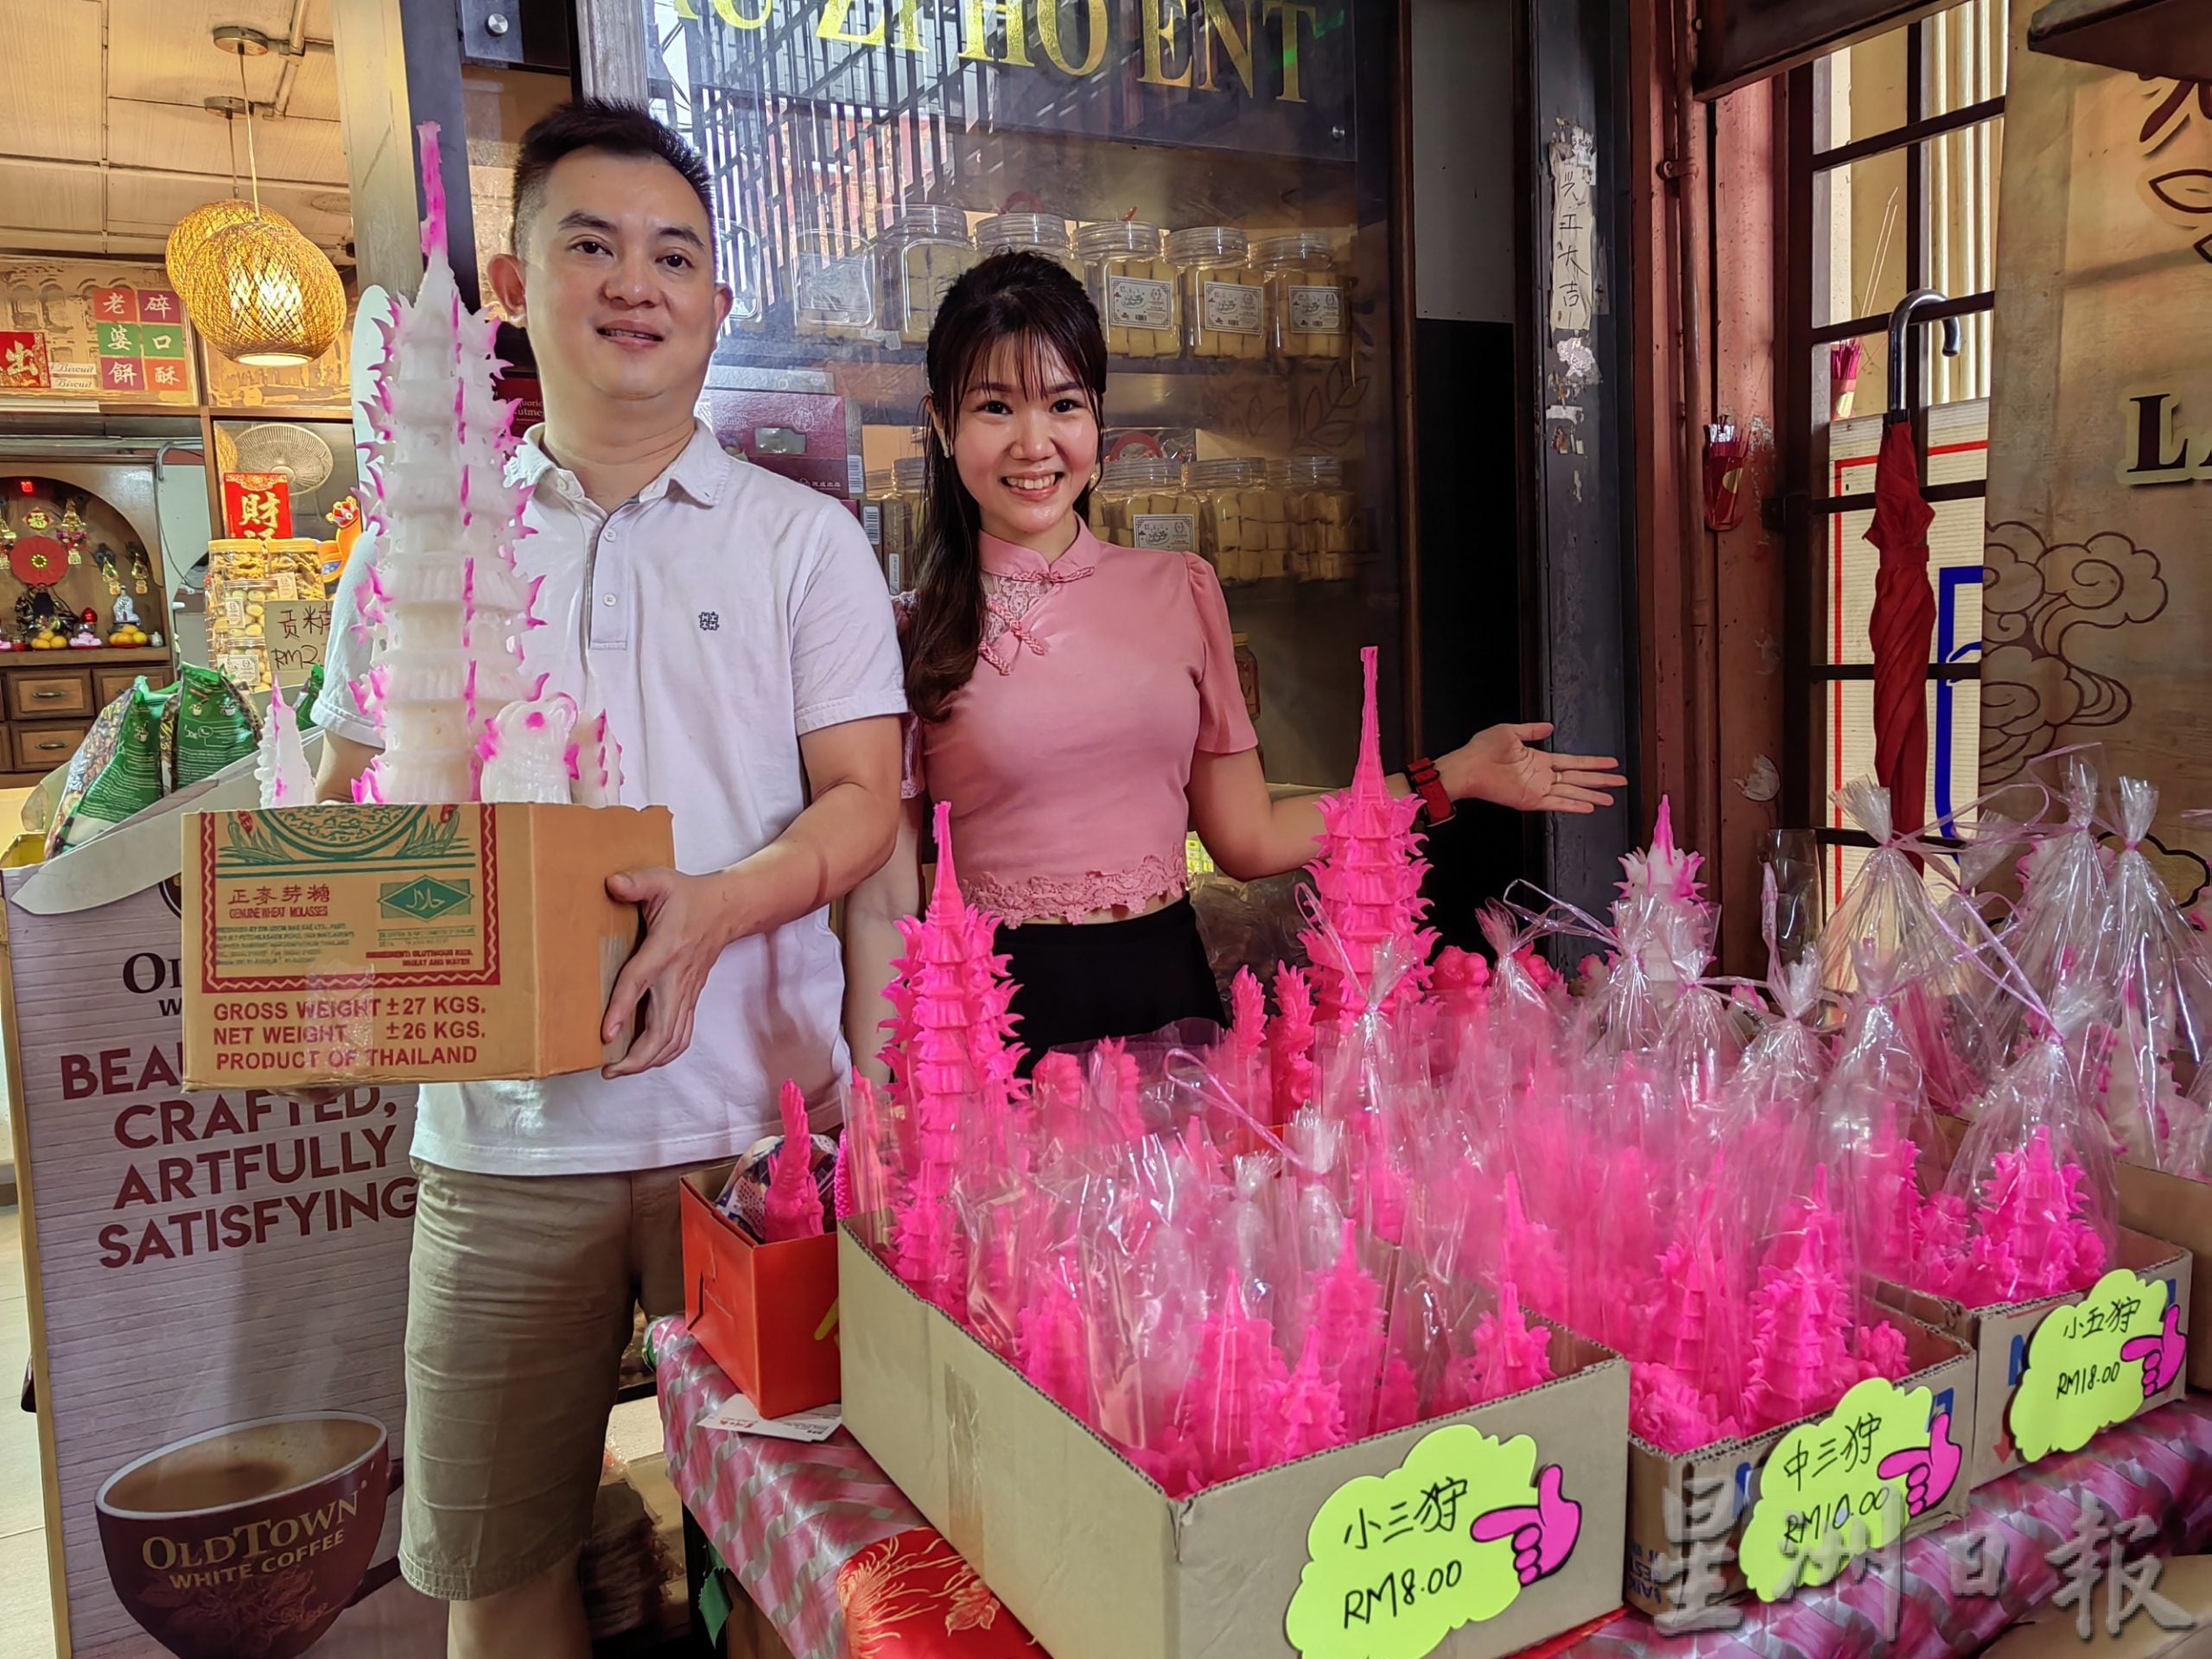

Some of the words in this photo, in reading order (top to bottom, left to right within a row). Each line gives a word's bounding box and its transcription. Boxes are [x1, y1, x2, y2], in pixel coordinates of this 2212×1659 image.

[1137, 0, 1308, 103] ENT
[103, 292, 137, 387] 老婆餅
[144, 294, 181, 385] 碎口酥
[213, 1002, 288, 1021] GROSS
[296, 999, 381, 1019] WEIGHT
[434, 995, 486, 1014] KGS.
[213, 1027, 254, 1045] NET
[263, 1025, 347, 1044] WEIGHT
[434, 1020, 486, 1039] KGS.
[216, 1051, 321, 1070] PRODUCT
[328, 1049, 357, 1068] OF
[369, 1046, 477, 1066] THAILAND
[113, 1124, 397, 1210] ARTFULLY
[98, 1176, 417, 1268] SATISFYING
[2056, 1361, 2120, 1399] RM18.00
[1783, 1486, 1891, 1550] RM10.00
[169, 1564, 253, 1590] WHITE
[262, 1529, 345, 1574] COFFEE
[1344, 1560, 1463, 1630] RM8.00
